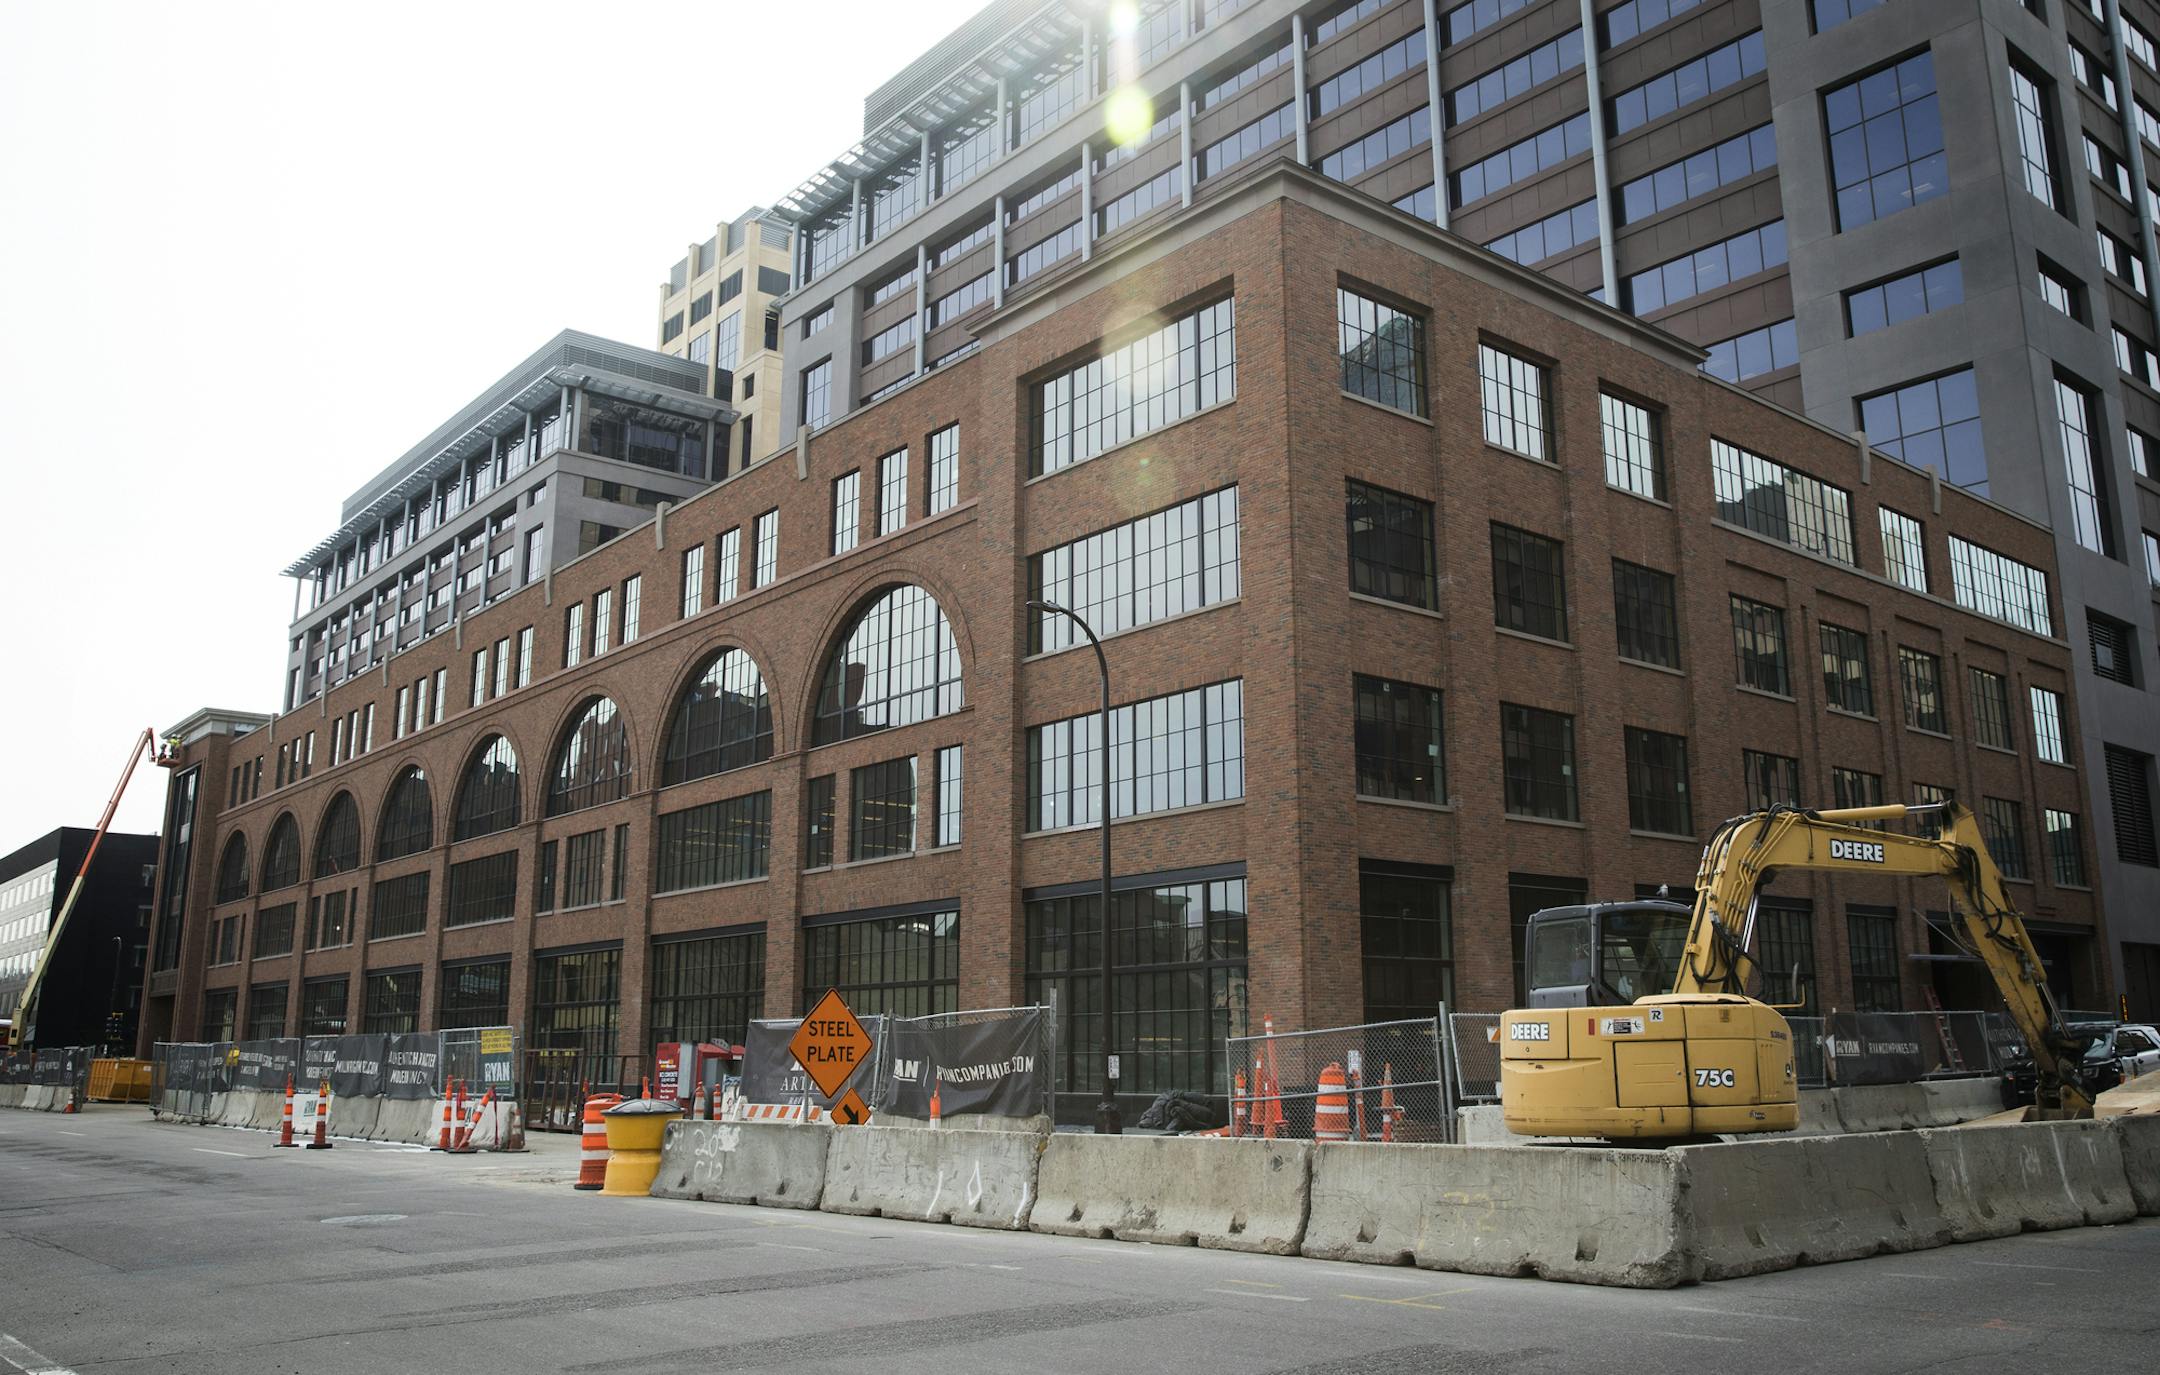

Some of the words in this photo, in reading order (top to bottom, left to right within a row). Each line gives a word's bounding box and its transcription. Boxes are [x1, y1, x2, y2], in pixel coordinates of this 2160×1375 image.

[1831, 839, 1884, 863] DEERE
[1651, 1010, 1662, 1020] R
[808, 1021, 854, 1037] STEEL
[1511, 1023, 1549, 1041] DEERE
[807, 1046, 854, 1062] PLATE
[1836, 1040, 1860, 1054] RYAN
[484, 1062, 510, 1082] RYAN
[1695, 1068, 1735, 1088] 75C
